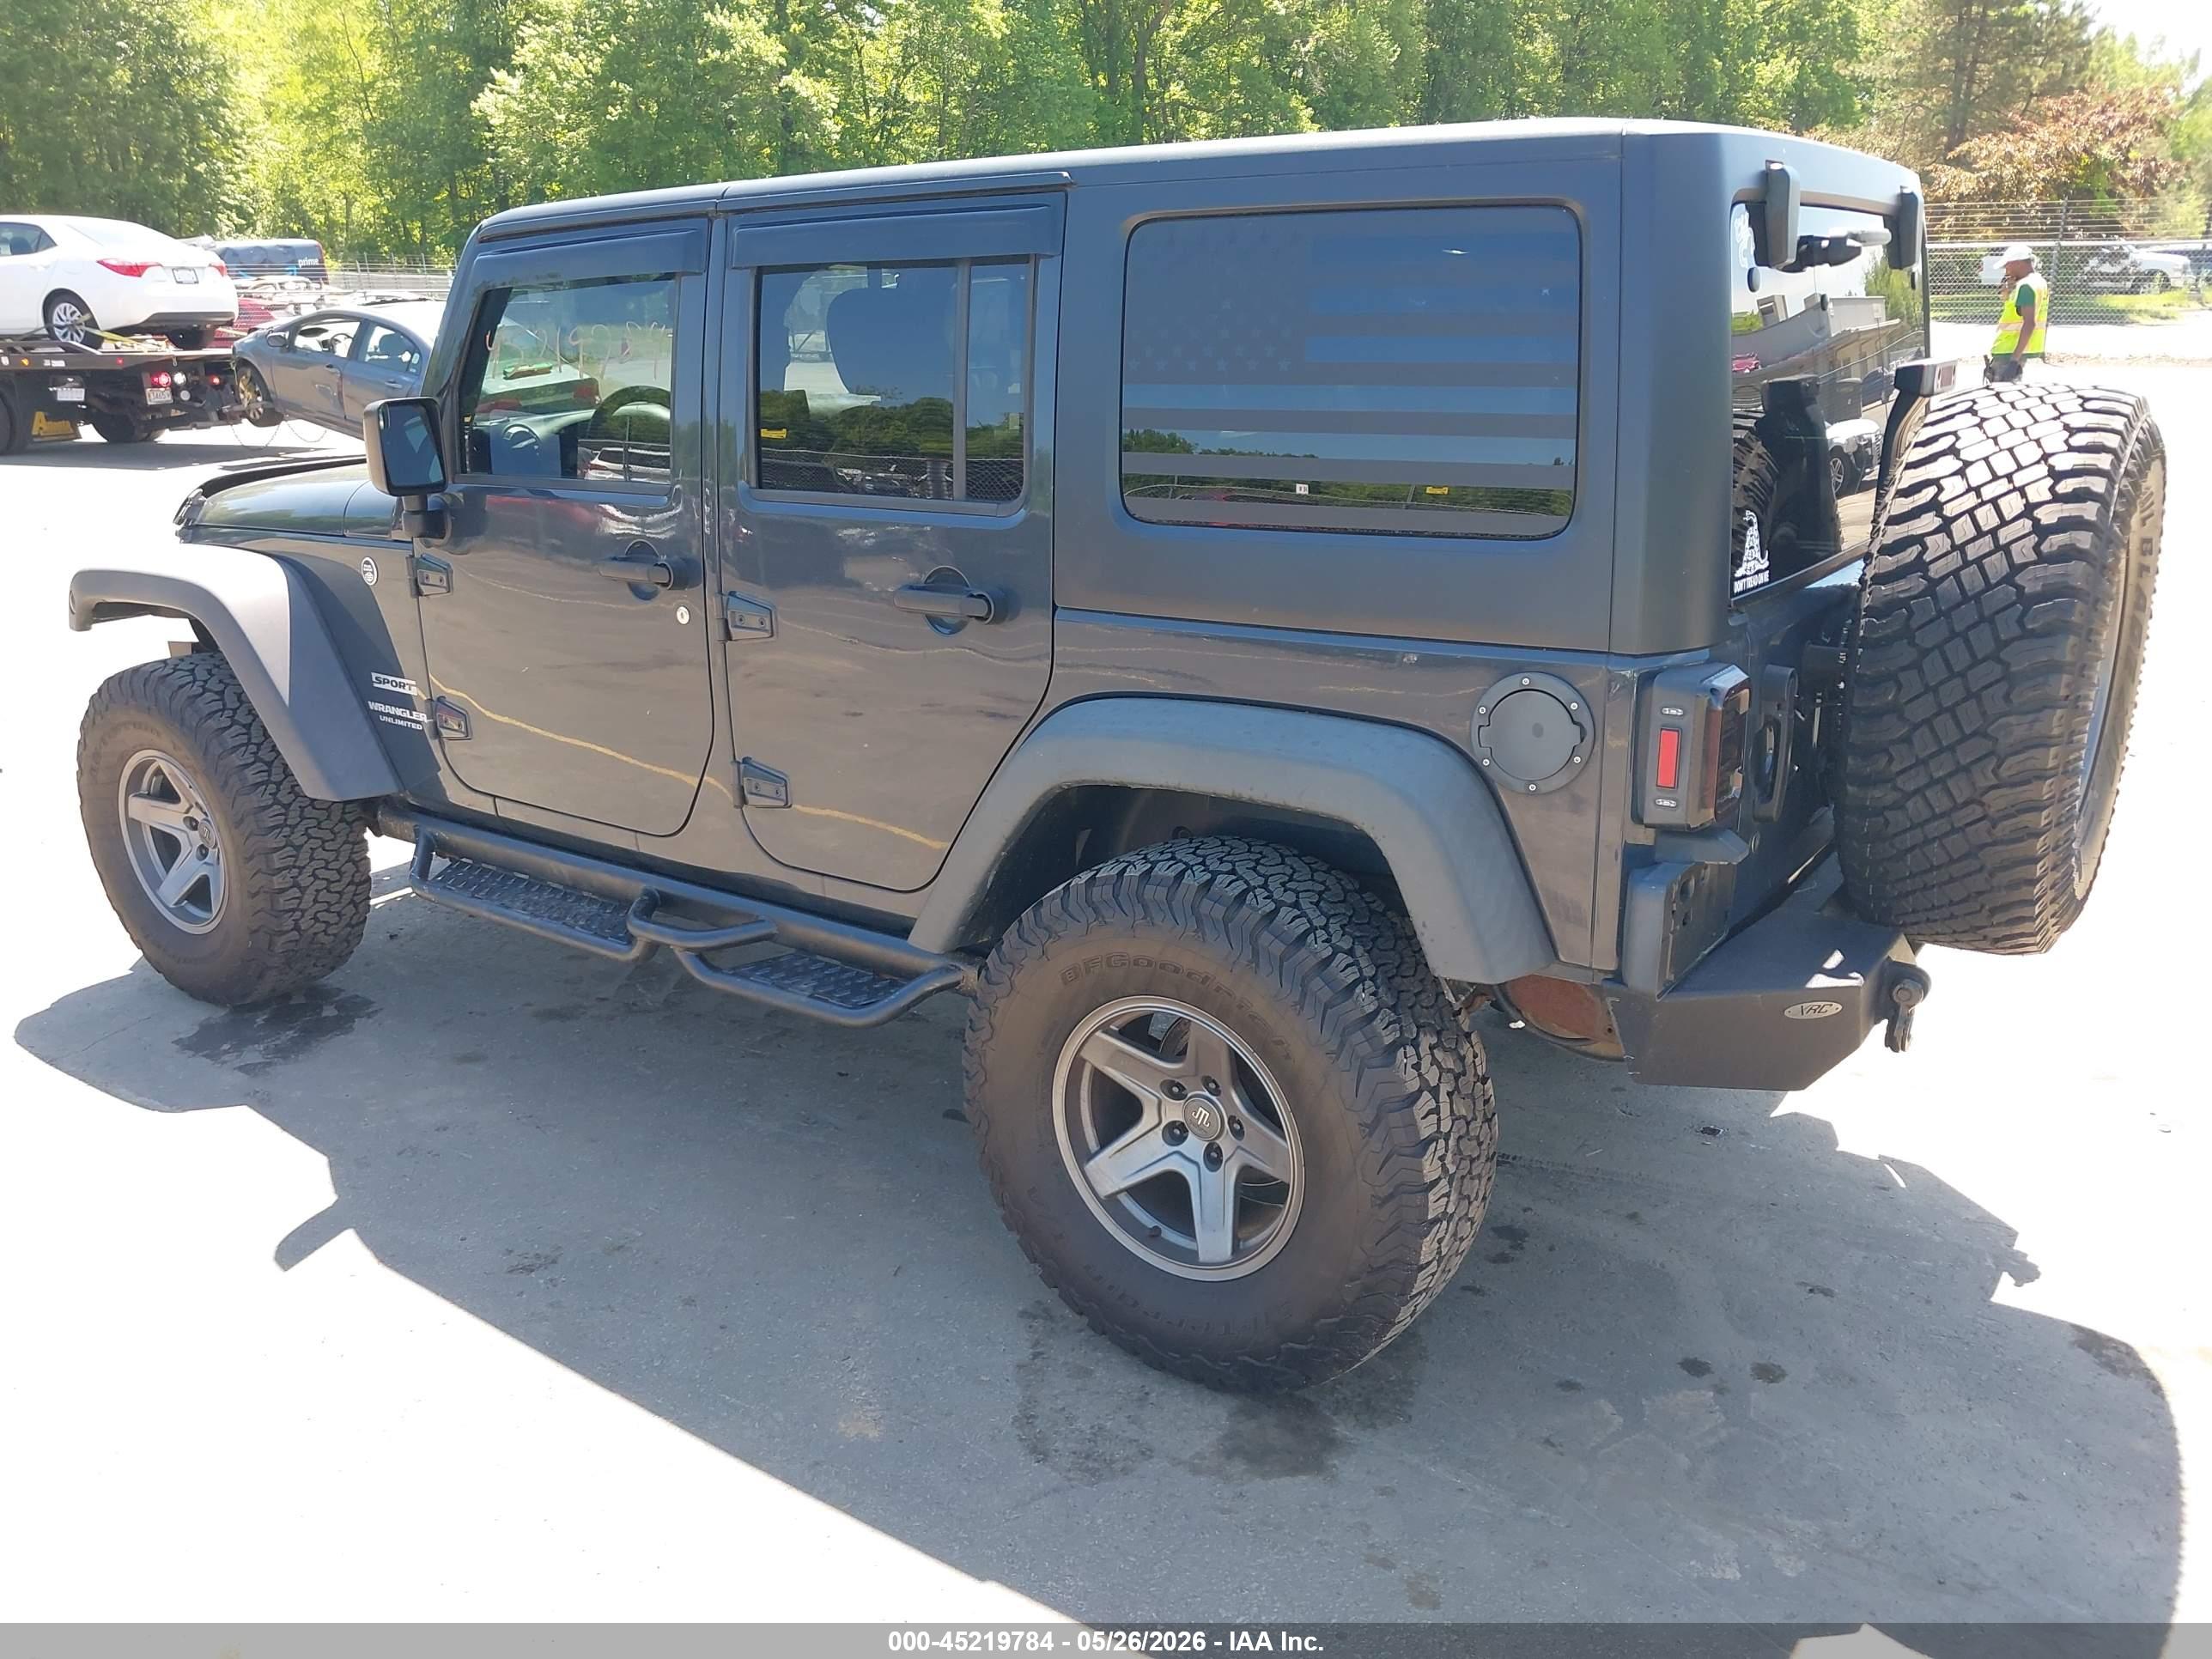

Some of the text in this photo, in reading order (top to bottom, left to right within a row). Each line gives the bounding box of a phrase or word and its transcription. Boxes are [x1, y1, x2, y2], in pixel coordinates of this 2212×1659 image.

[298, 257, 319, 268] prime
[374, 676, 416, 692] SPORT
[368, 701, 428, 723] WRANGLER
[379, 714, 423, 731] UNLIMITED
